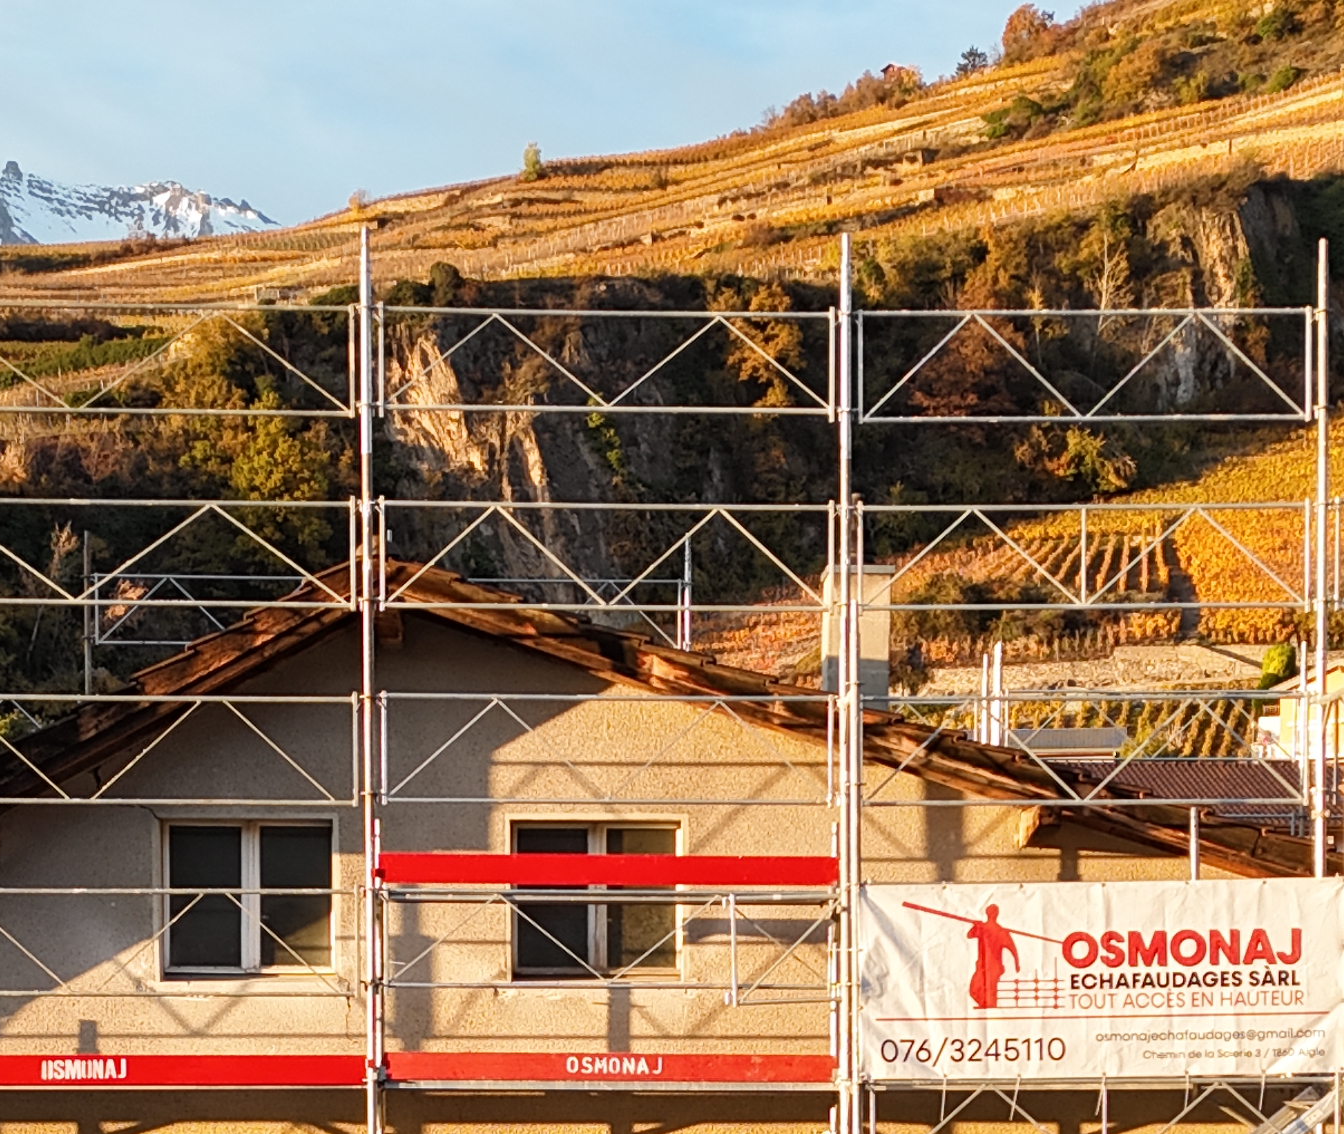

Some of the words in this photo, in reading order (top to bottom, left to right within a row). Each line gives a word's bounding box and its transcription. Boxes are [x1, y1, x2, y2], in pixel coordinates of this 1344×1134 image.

[1061, 928, 1302, 968] OSMONAJ
[1070, 972, 1243, 990] ECHAFAUDAGES
[1248, 966, 1301, 987] SÀRL
[1069, 993, 1118, 1010] TOUT
[1122, 987, 1187, 1009] ACCÈS
[1191, 993, 1214, 1008] EN
[1219, 990, 1305, 1007] HAUTEUR
[881, 1037, 1066, 1067] 076/3245110
[565, 1056, 663, 1074] OSMONAJ
